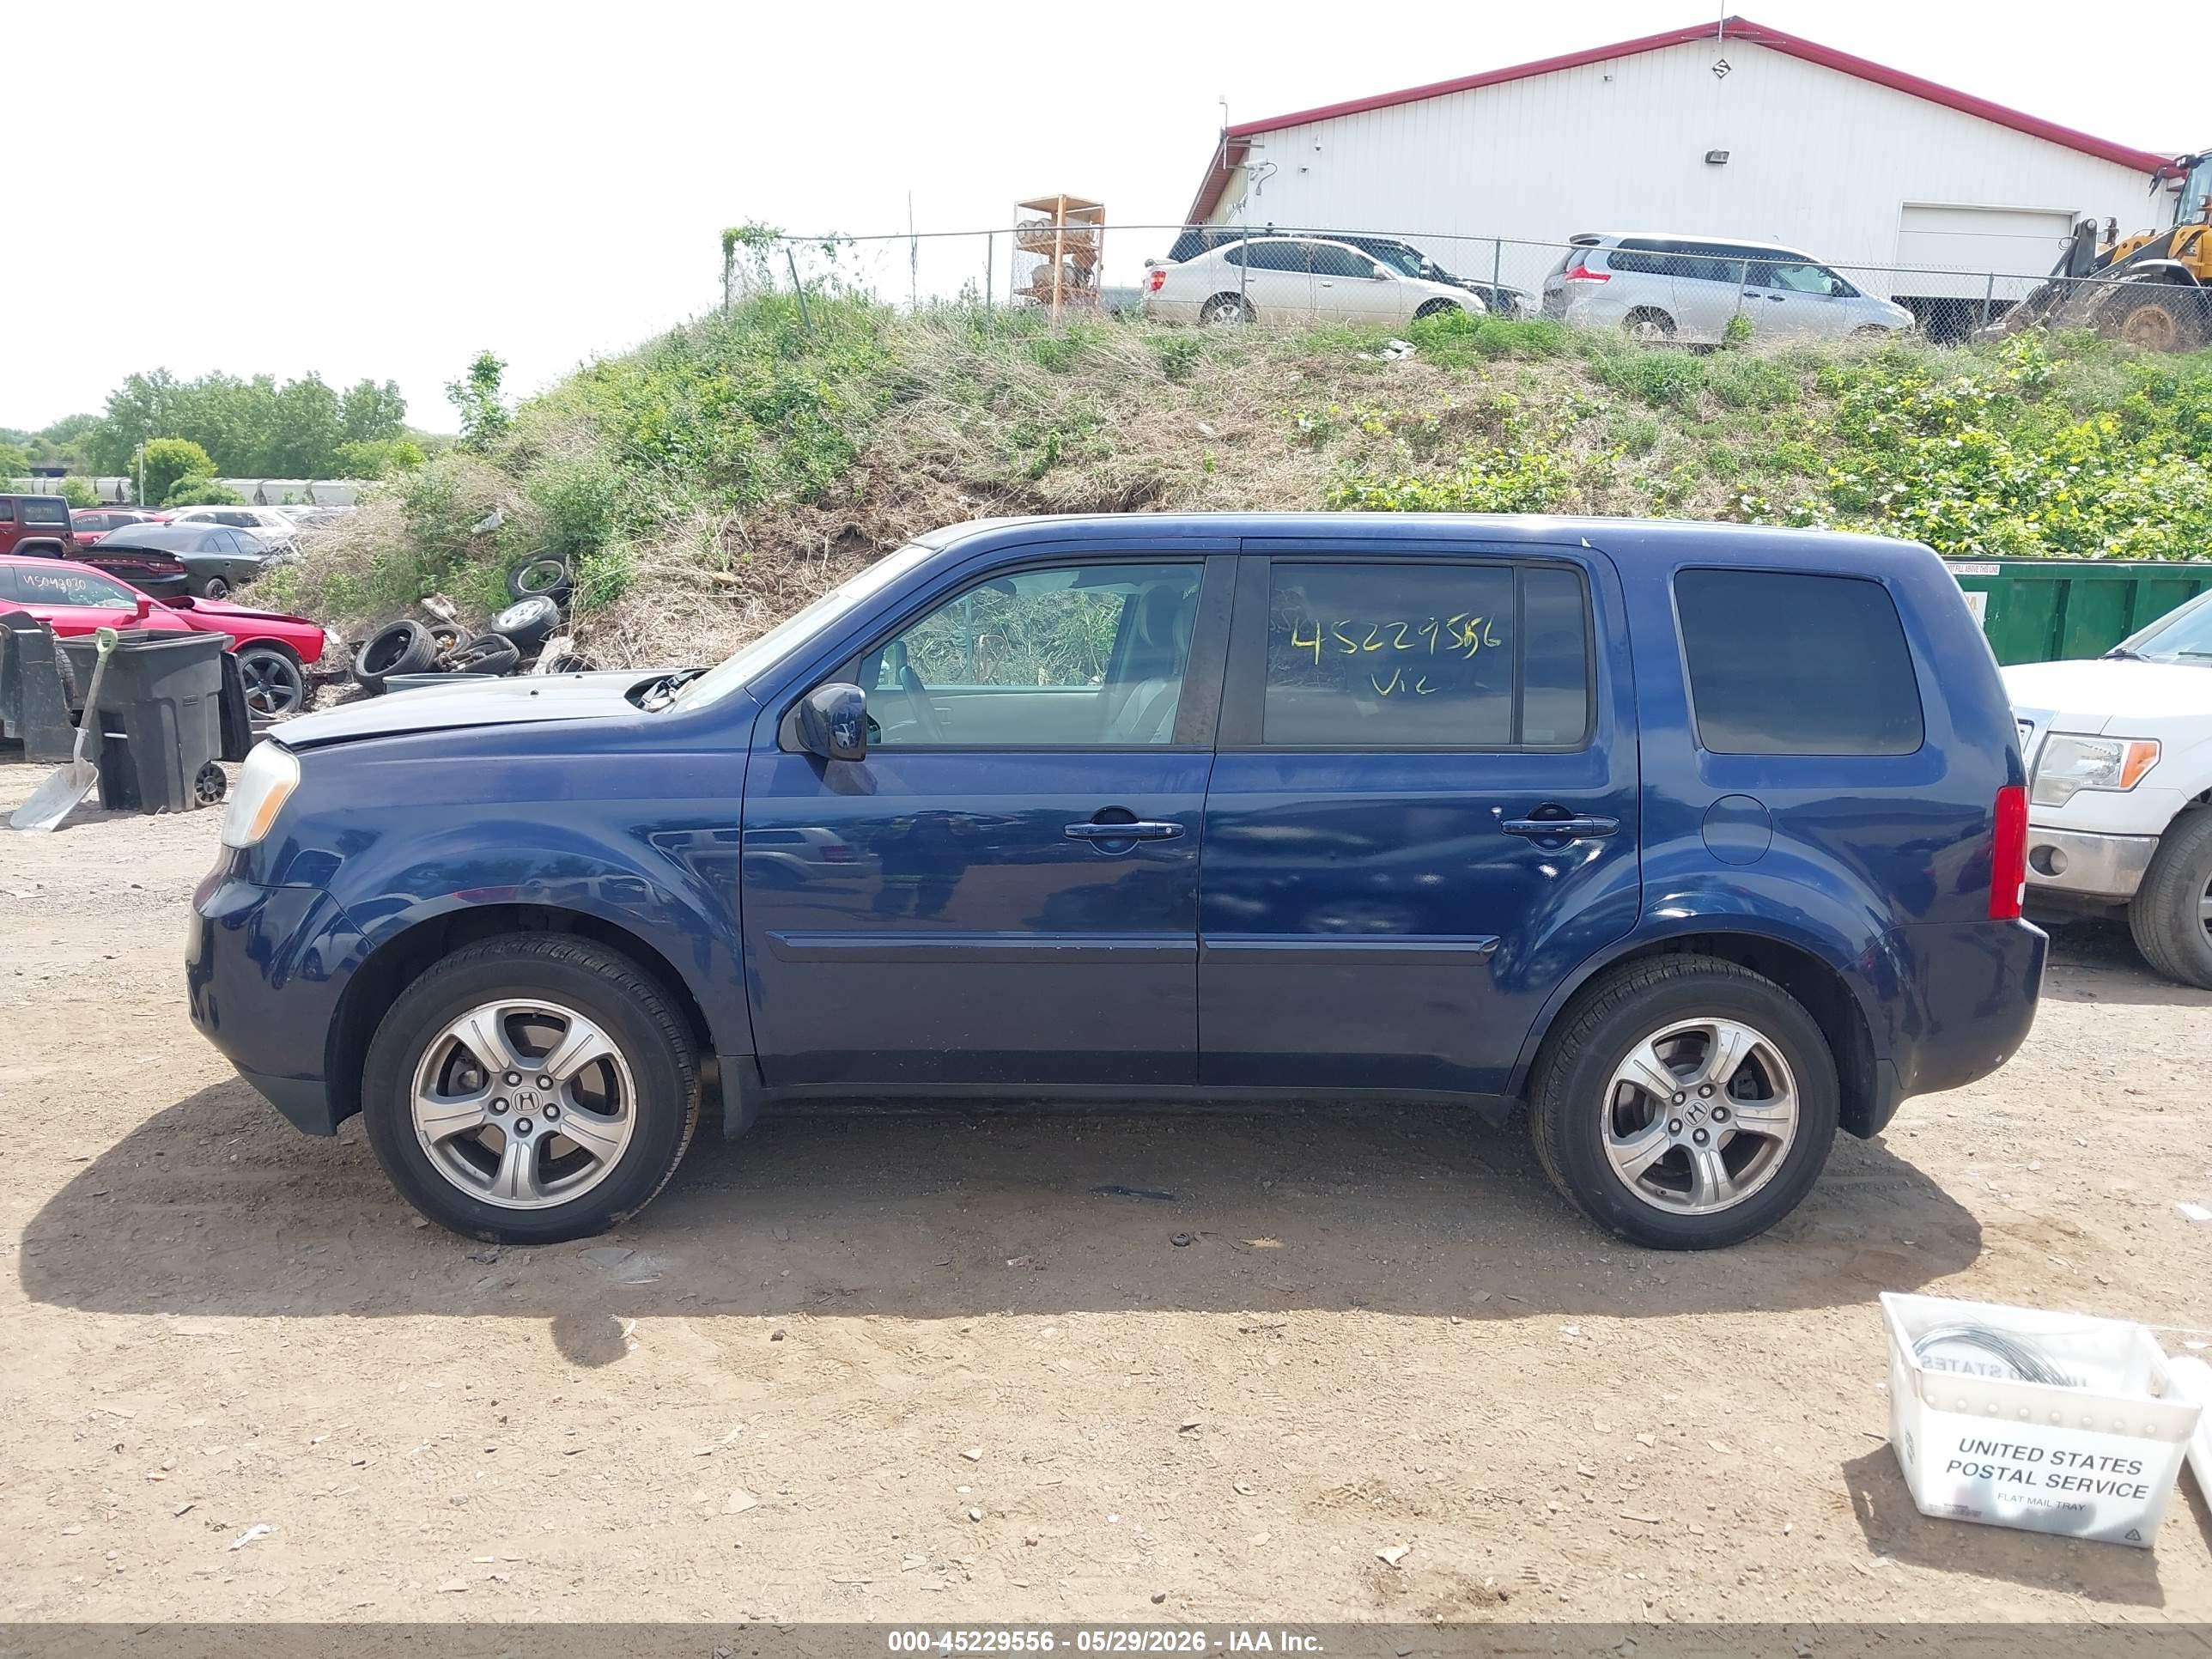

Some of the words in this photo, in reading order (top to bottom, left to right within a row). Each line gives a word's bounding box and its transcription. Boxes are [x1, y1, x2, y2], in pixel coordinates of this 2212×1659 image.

[1955, 564, 1964, 573] FILL
[1964, 564, 1979, 573] ABOVE
[1979, 564, 1989, 574] THIS
[1989, 565, 1998, 574] LINE
[1959, 1437, 2044, 1462] UNITED
[2050, 1450, 2143, 1475] STATES
[1946, 1460, 2038, 1486] POSTAL
[2045, 1474, 2149, 1499] SERVICE
[1996, 1492, 2025, 1503] FLAT
[2027, 1497, 2052, 1508] MAIL
[2056, 1501, 2087, 1511] TRAY
